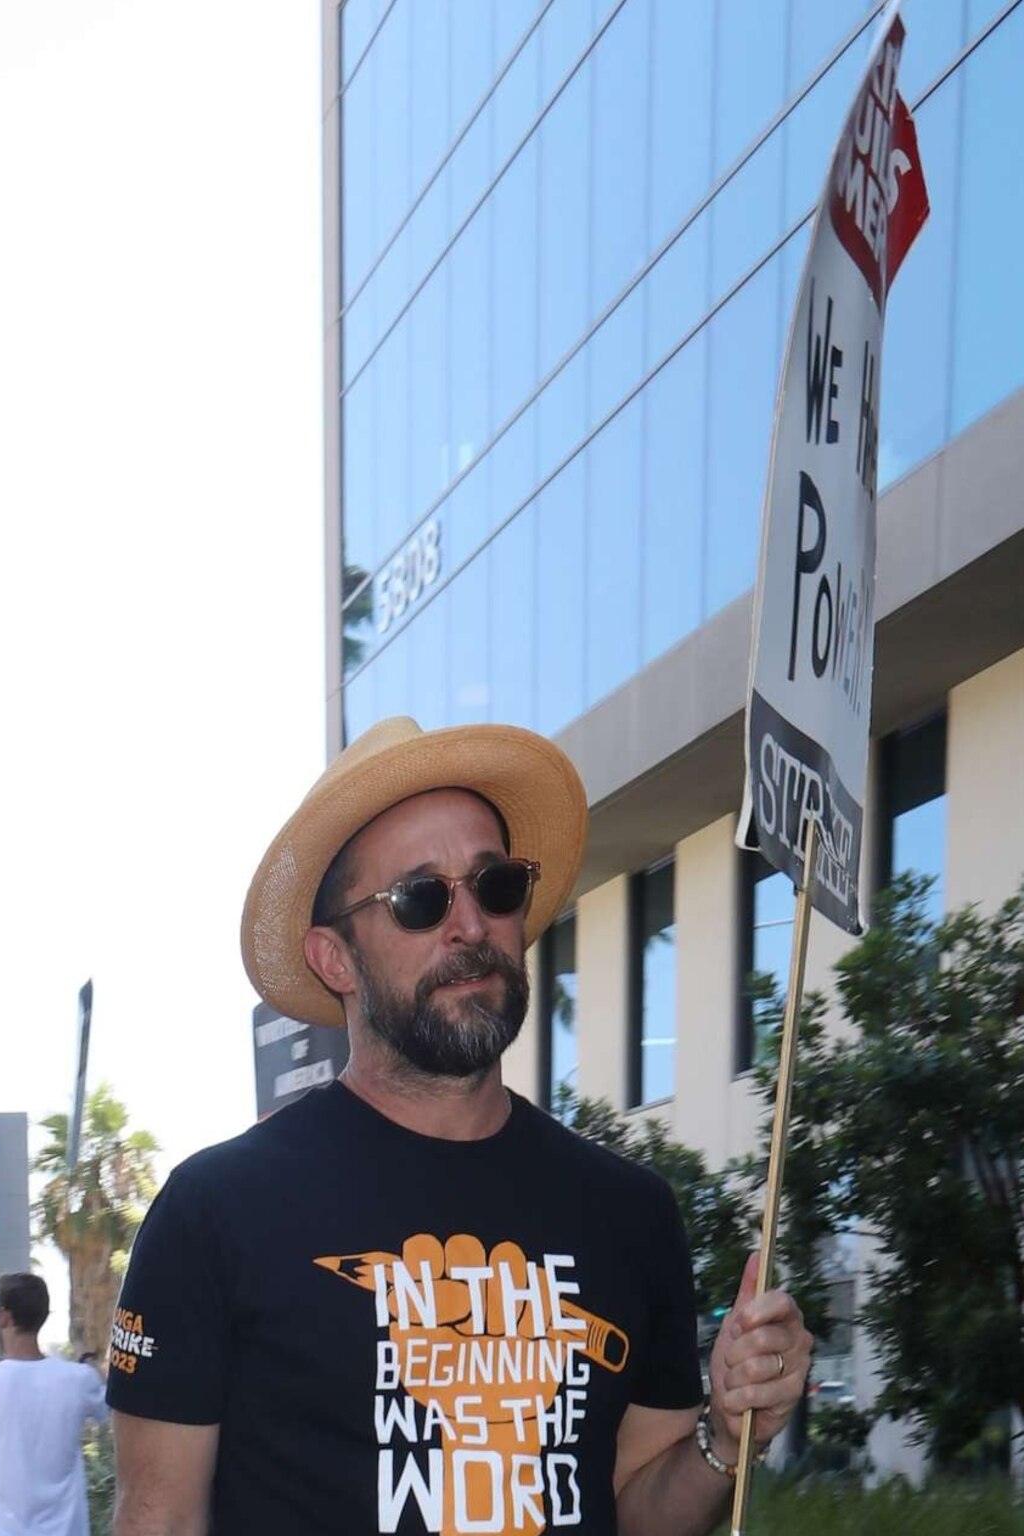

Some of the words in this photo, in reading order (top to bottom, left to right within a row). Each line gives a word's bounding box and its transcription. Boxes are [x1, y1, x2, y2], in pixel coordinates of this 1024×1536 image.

[806, 278, 844, 445] WE
[376, 519, 441, 634] 5808
[373, 1259, 437, 1330] IN
[450, 1253, 587, 1337] THE
[110, 1347, 137, 1373] 023
[375, 1336, 591, 1390] BEGINNING
[374, 1394, 489, 1445] WAS
[500, 1389, 588, 1447] THE
[377, 1449, 583, 1533] WORD
